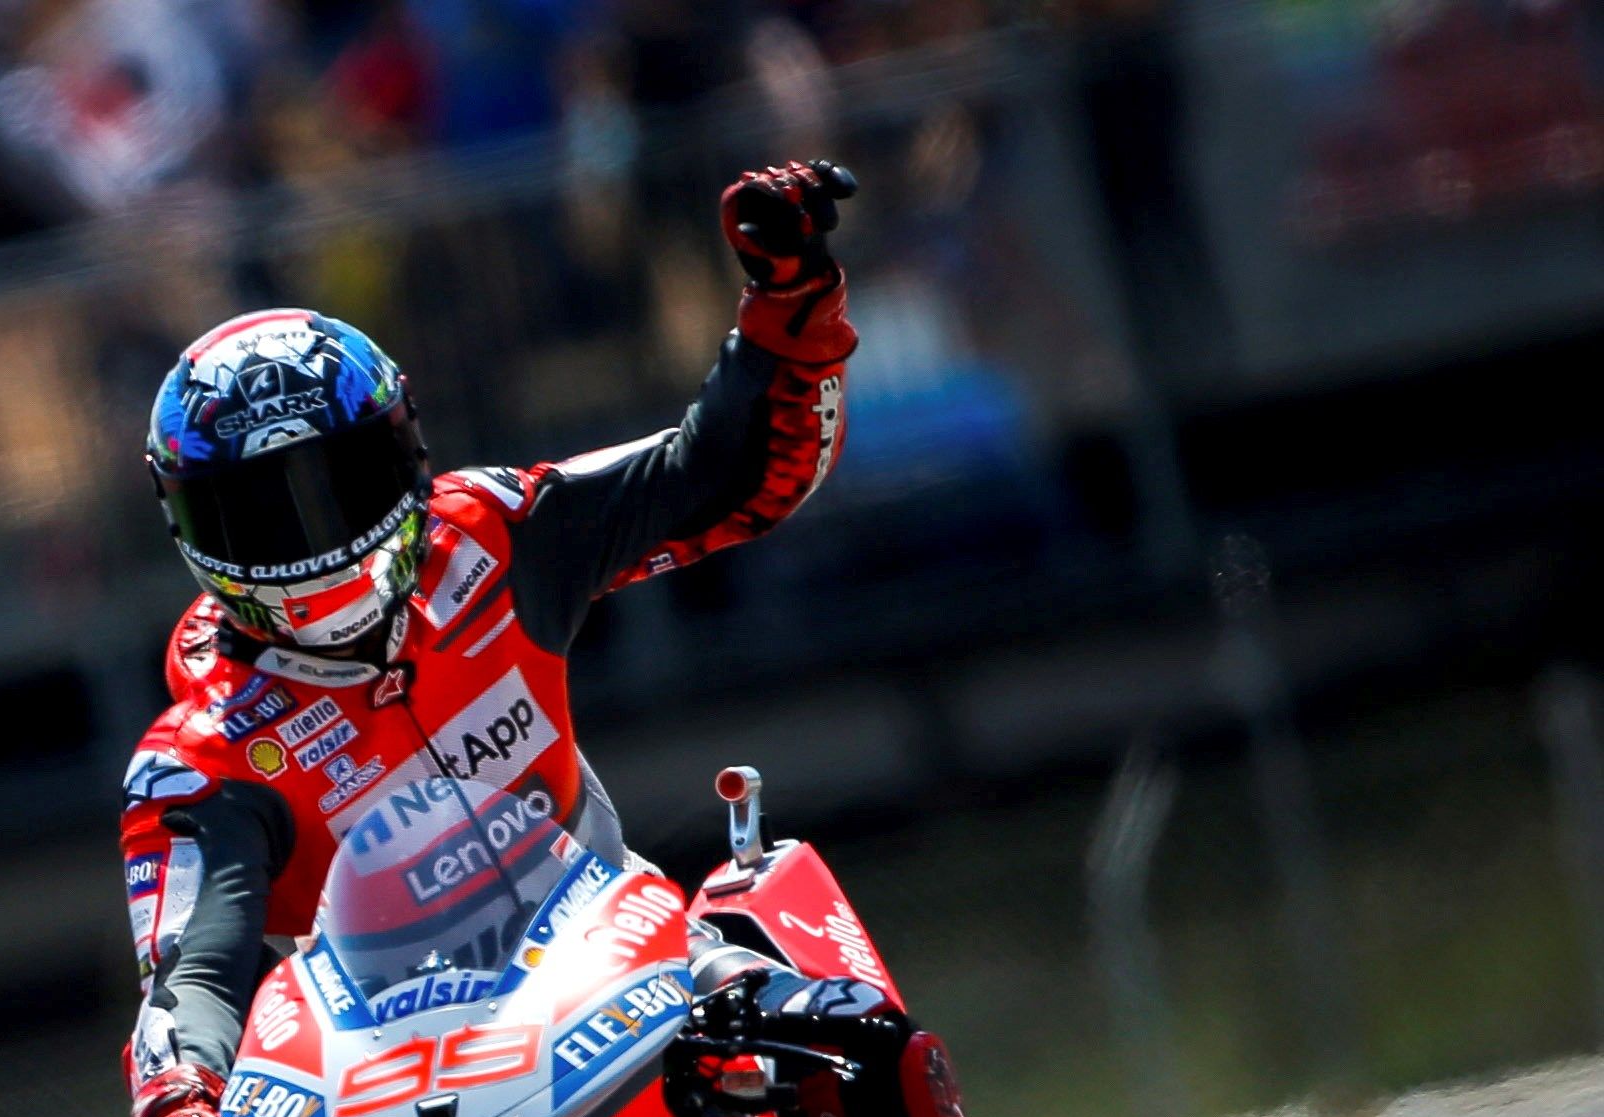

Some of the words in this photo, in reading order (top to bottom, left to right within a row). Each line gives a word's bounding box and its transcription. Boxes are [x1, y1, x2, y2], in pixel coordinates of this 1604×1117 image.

[215, 387, 328, 438] SHARK
[452, 557, 490, 604] DUCATI
[330, 607, 380, 642] DUCATI
[290, 700, 338, 739] riello
[389, 698, 534, 829] NetApp
[406, 790, 552, 901] Lenovo
[376, 972, 495, 1027] valsir
